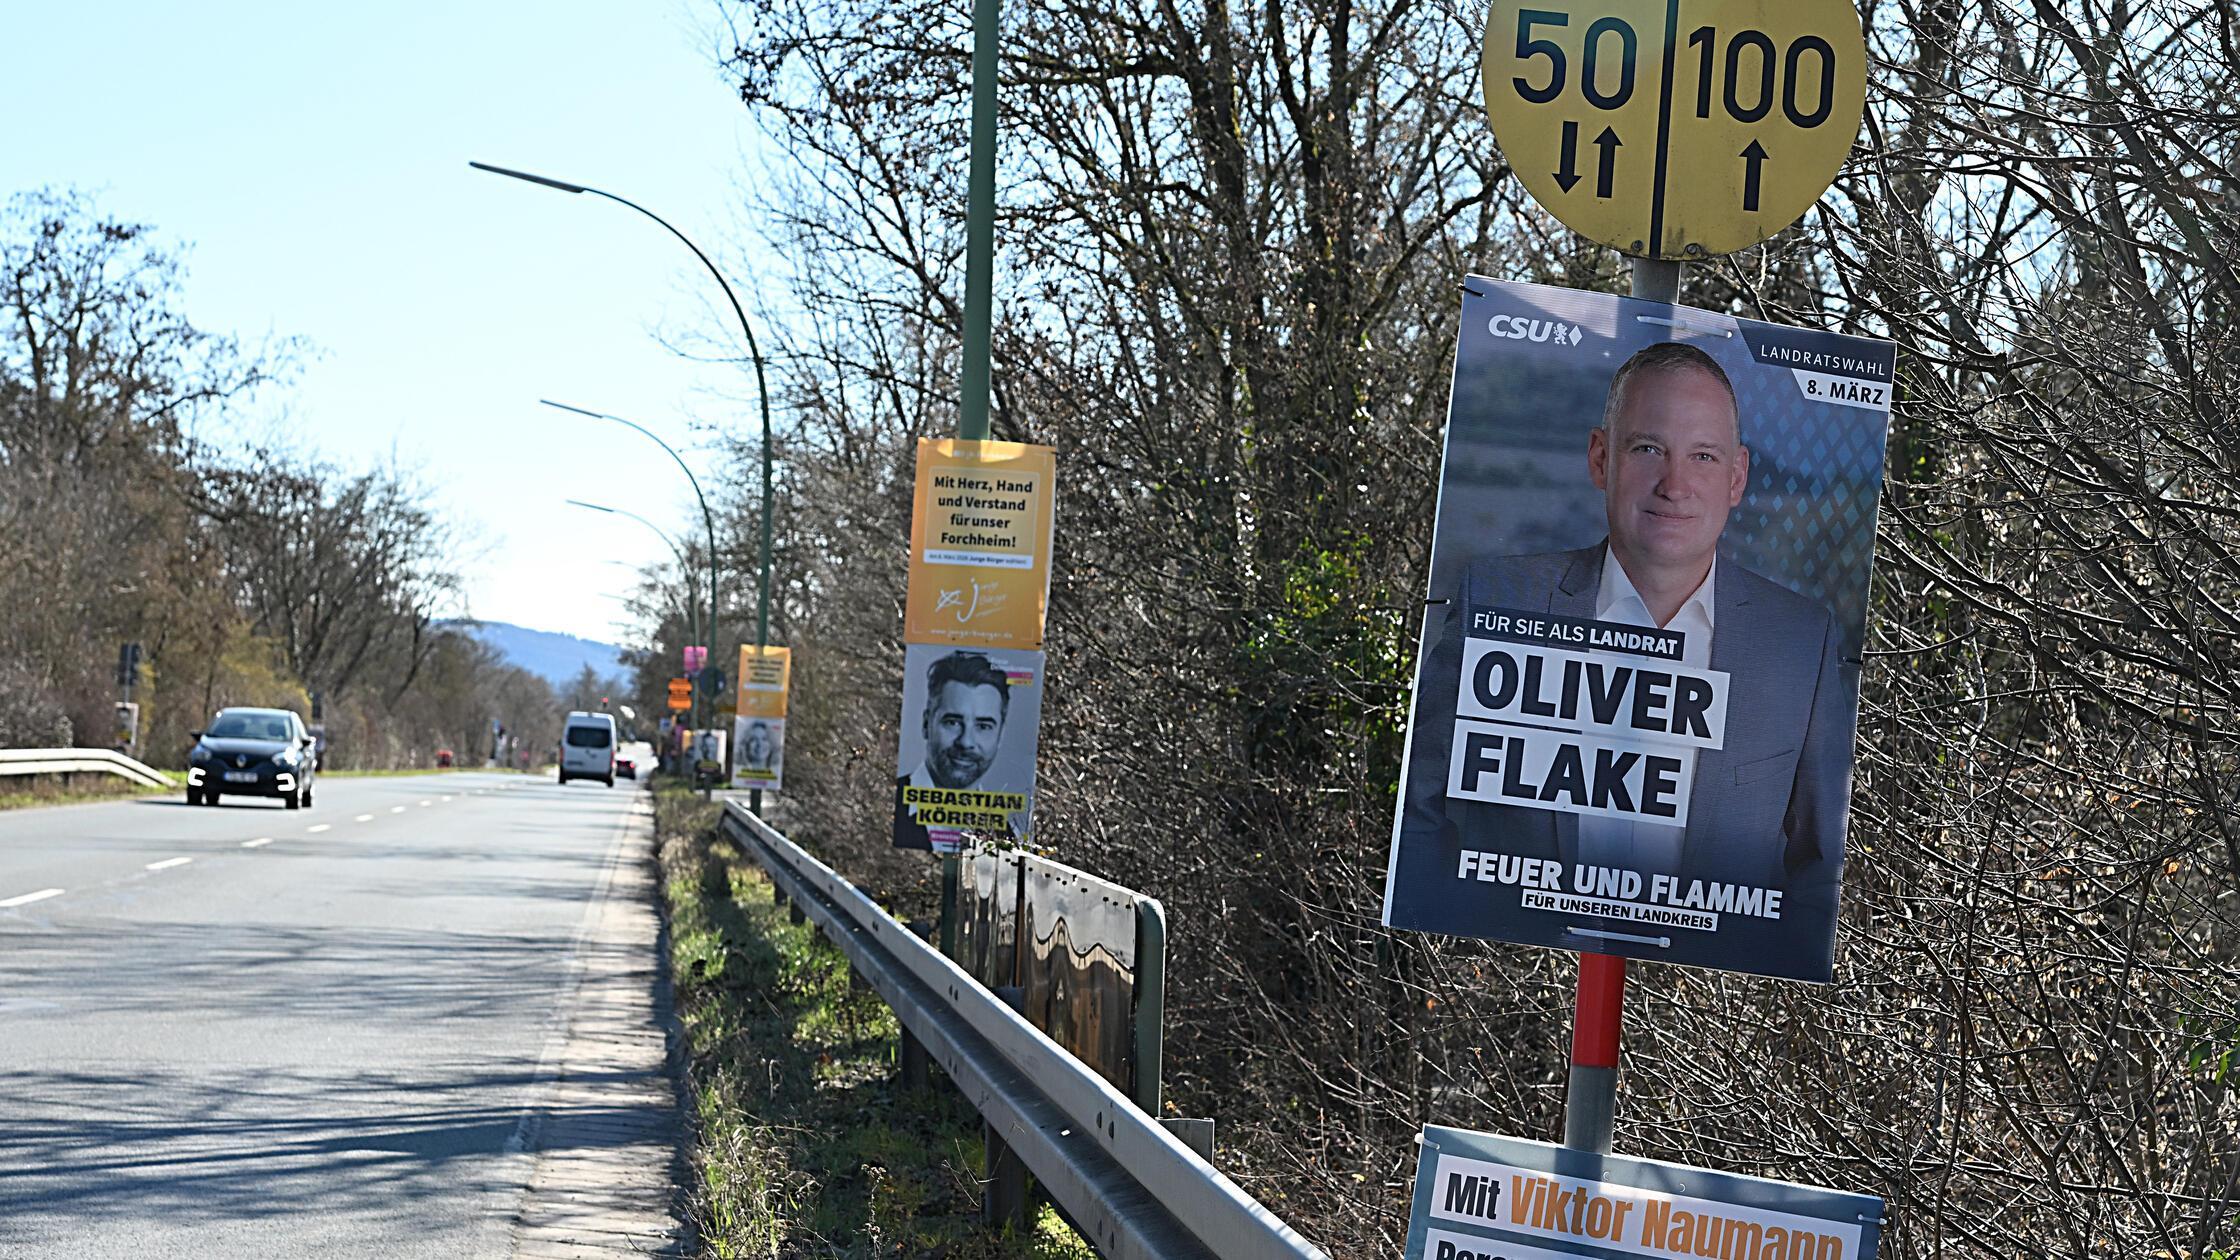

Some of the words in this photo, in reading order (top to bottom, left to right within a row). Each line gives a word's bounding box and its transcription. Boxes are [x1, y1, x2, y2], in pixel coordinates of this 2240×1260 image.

[1512, 9, 1637, 110] 50
[1689, 26, 1835, 129] 100
[1488, 314, 1553, 343] CSU
[1761, 344, 1885, 376] LANDRATSWAHL
[1807, 379, 1823, 396] 8.
[1829, 381, 1884, 405] MÄRZ
[934, 476, 955, 489] Mit
[957, 477, 993, 493] Herz,
[996, 480, 1034, 493] Hand
[938, 496, 962, 508] und
[965, 497, 1026, 511] Verstand
[950, 513, 970, 527] für
[972, 517, 1011, 529] unser
[941, 532, 1017, 548] Forchheim!
[1474, 610, 1510, 632] FÜR
[1514, 618, 1544, 637] SIE
[1549, 623, 1584, 642] ALS
[1589, 628, 1678, 655] LANDRAT
[1472, 650, 1714, 739] OLIVER
[1460, 731, 1682, 818] FLAKE
[905, 788, 1023, 810] SEBASTIAN
[1457, 849, 1563, 891] FEUER
[1573, 864, 1642, 900] UND
[1649, 874, 1783, 920] FLAMME
[1524, 891, 1555, 909] FÜR
[1559, 898, 1631, 920] UNSEREN
[1633, 906, 1714, 930] LANDKREIS
[1444, 1172, 1500, 1220] Mit
[1511, 1175, 1633, 1242] Viktor
[1640, 1198, 1844, 1260] Naumann
